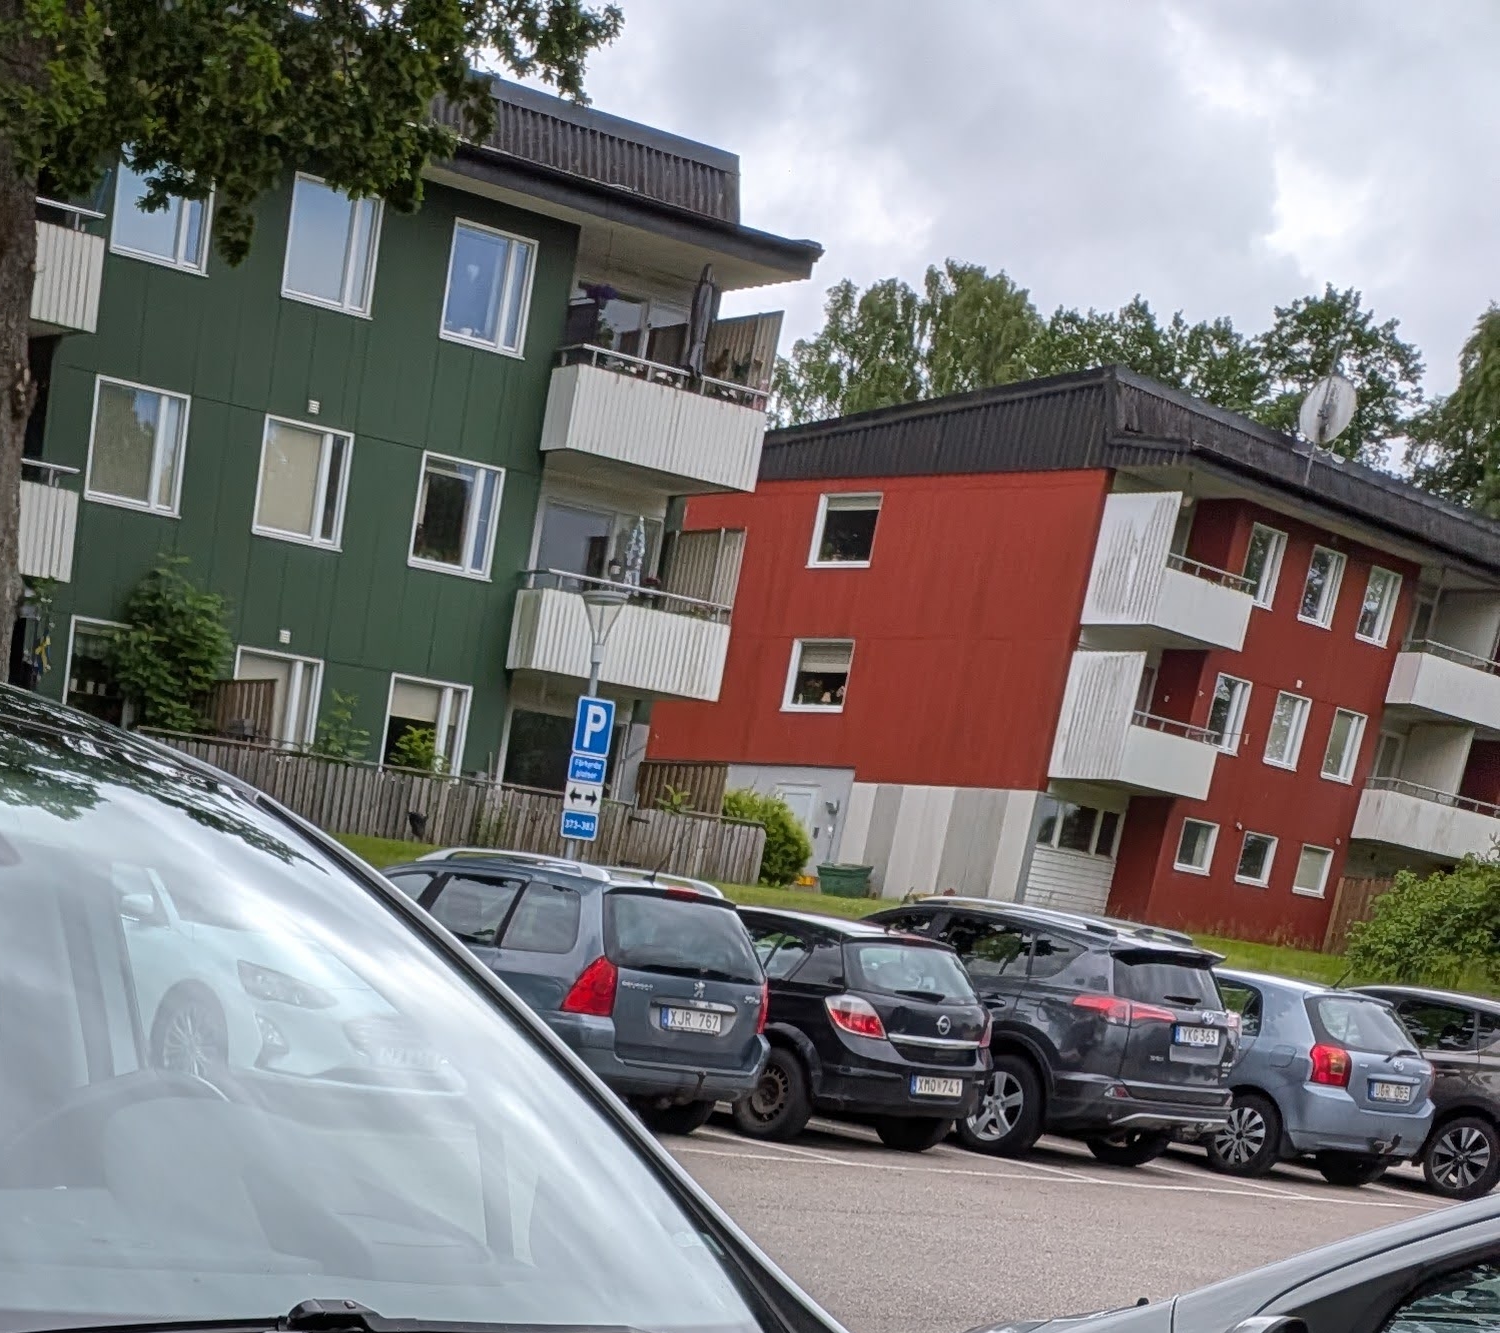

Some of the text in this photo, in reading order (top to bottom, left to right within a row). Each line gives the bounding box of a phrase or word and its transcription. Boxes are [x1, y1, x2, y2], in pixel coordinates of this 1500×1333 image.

[582, 704, 607, 749] P
[670, 1009, 719, 1029] XJR 767
[1182, 1028, 1199, 1042] YKG
[942, 1080, 960, 1094] 741
